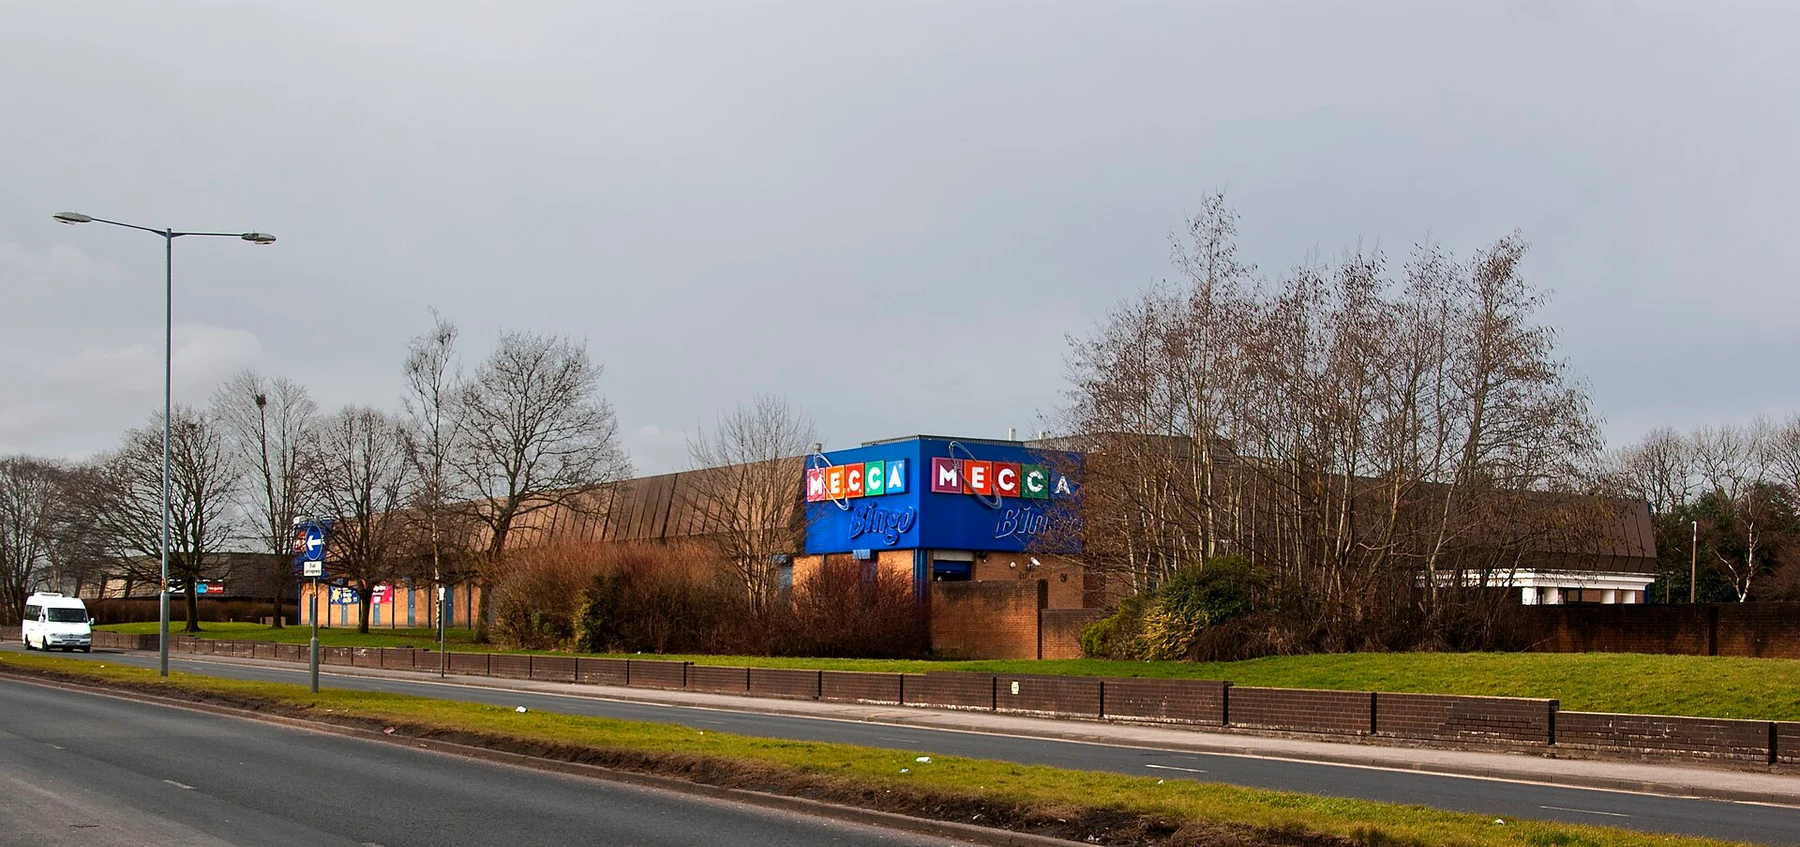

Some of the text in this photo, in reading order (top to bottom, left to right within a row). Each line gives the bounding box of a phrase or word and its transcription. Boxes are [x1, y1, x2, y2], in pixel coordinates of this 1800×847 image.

[809, 465, 902, 496] MECCA
[939, 464, 1072, 495] MECCA
[848, 502, 914, 546] Bingo
